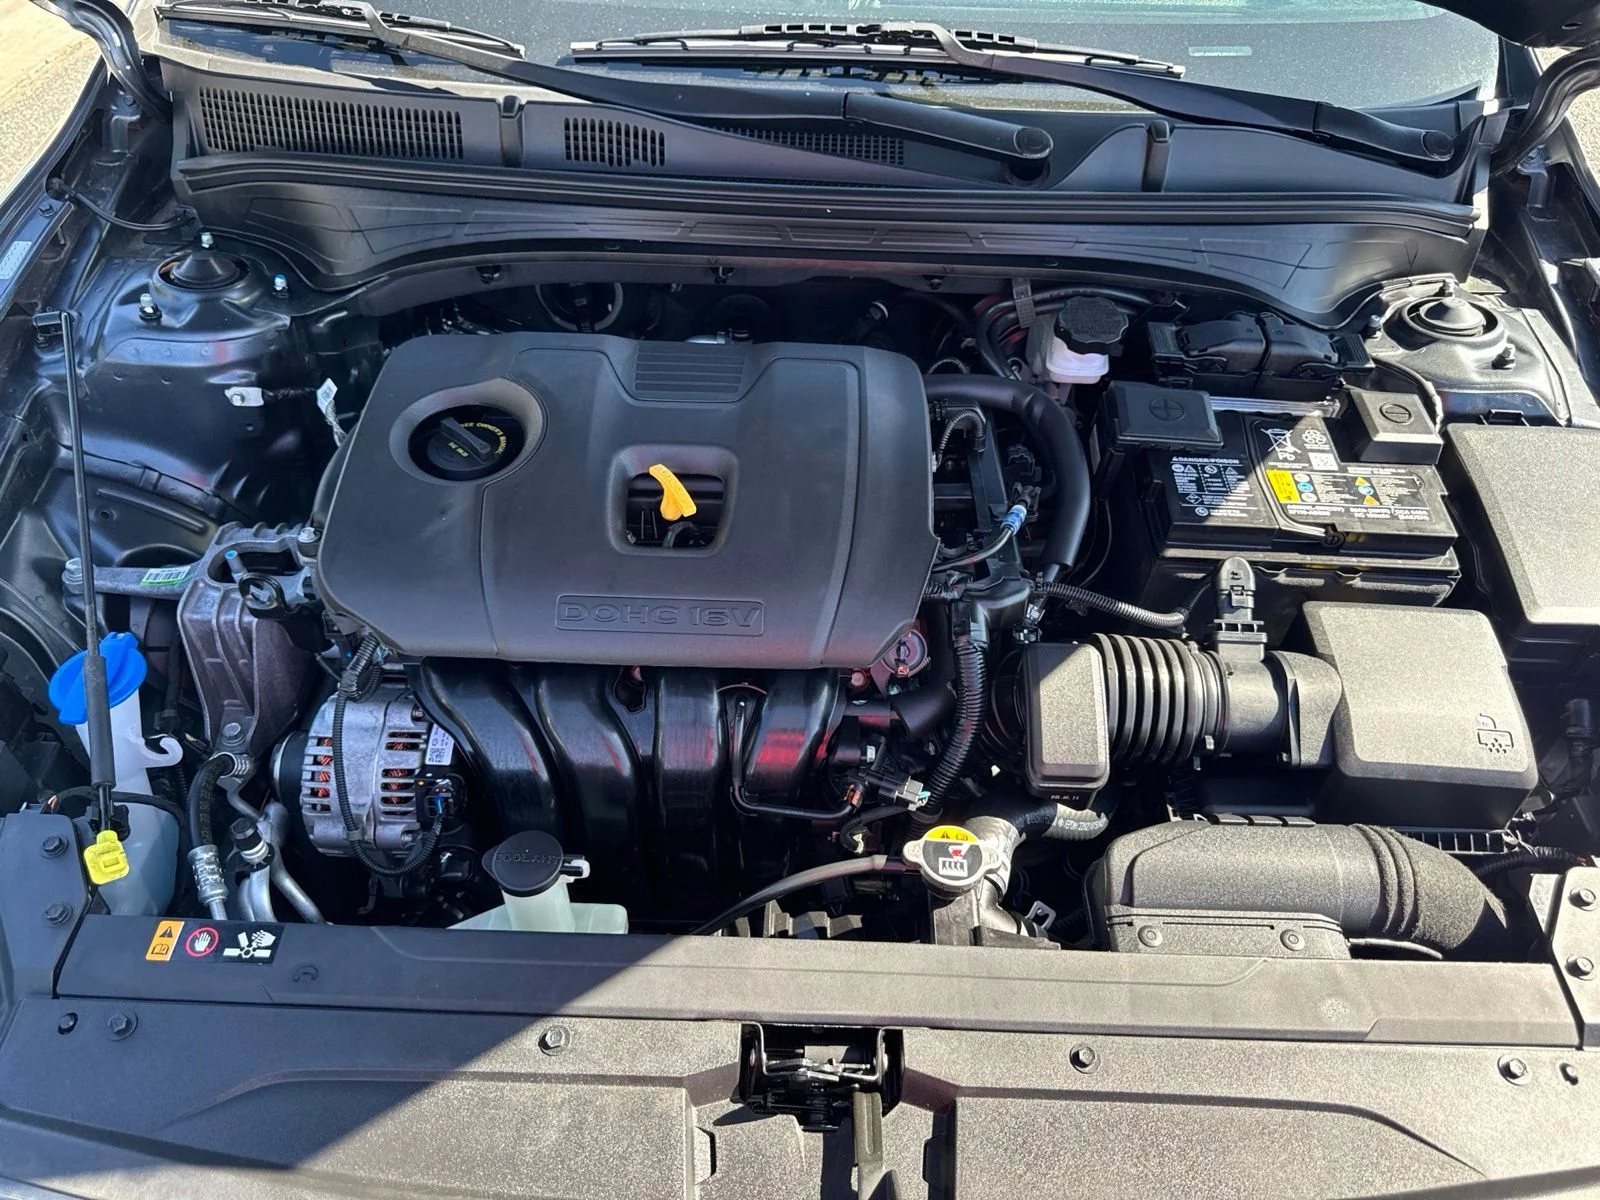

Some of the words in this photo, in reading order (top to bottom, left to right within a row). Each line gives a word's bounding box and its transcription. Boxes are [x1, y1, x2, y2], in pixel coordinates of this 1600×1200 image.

[476, 422, 504, 436] OWNER'S
[559, 602, 681, 625] DOHC
[690, 606, 761, 628] 16V
[496, 851, 559, 866] COOLANT
